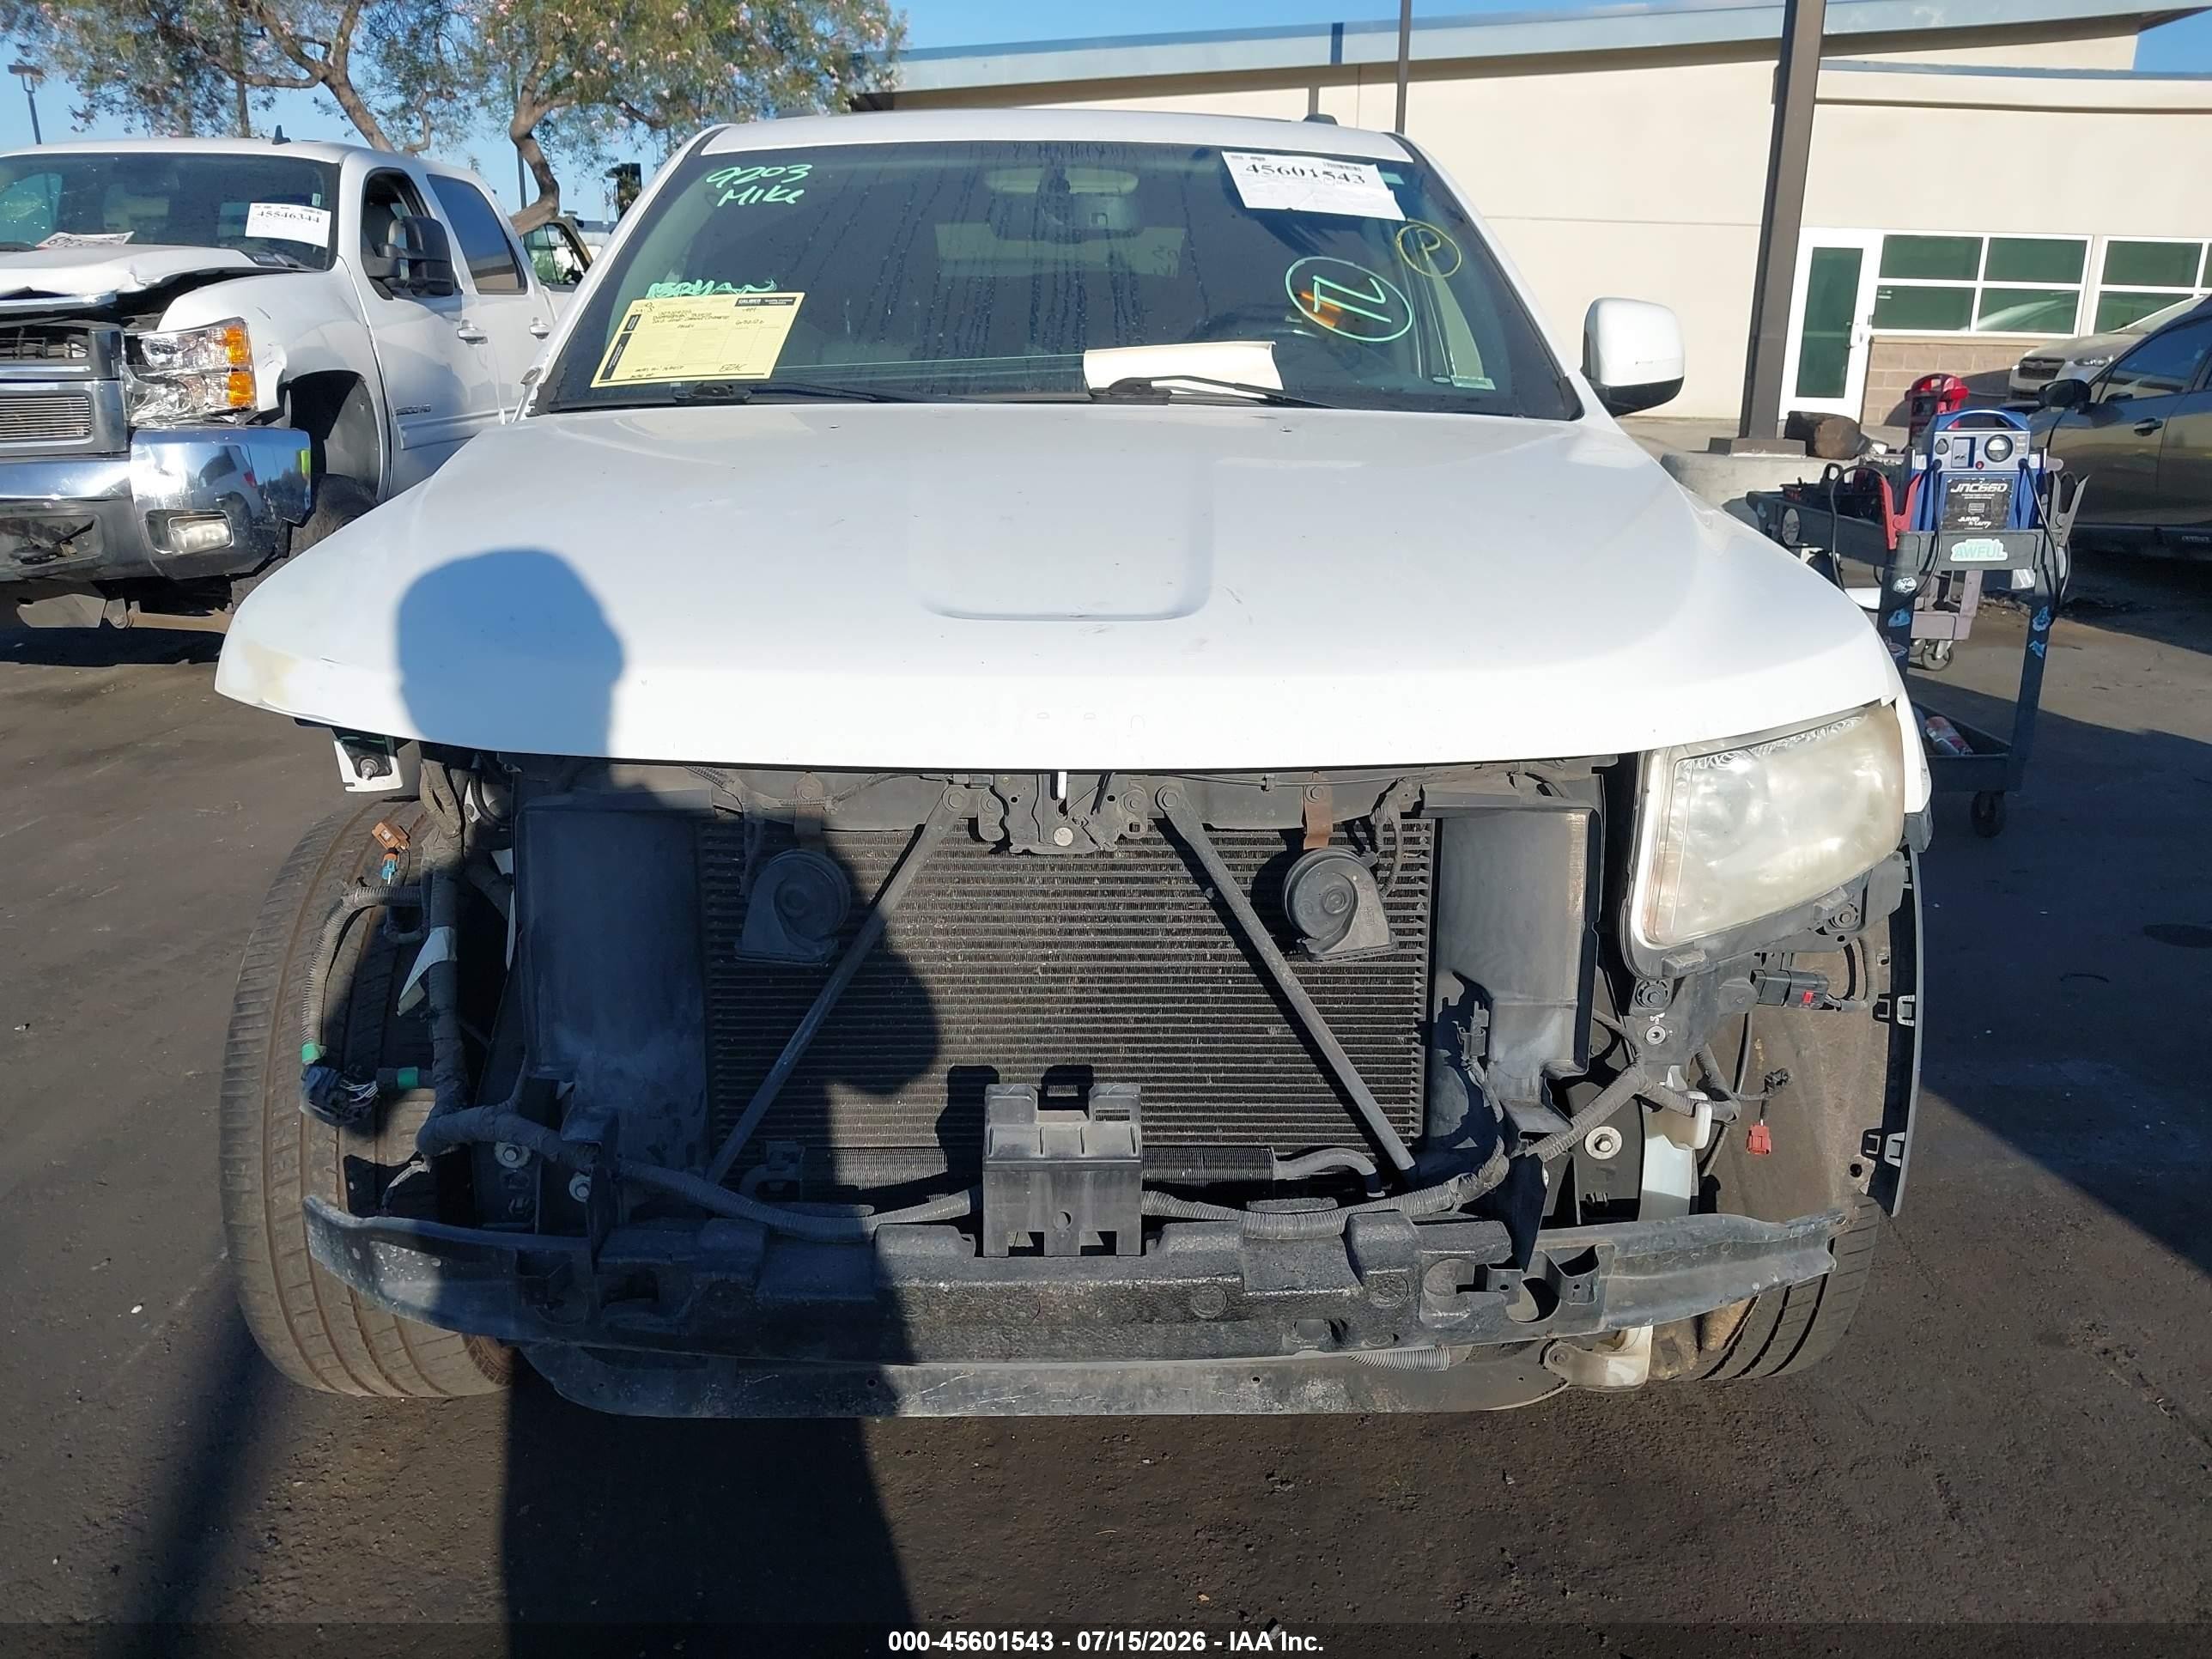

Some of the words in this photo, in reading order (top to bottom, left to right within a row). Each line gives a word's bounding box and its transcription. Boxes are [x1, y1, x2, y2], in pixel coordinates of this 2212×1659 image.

[706, 164, 813, 188] 9203
[1245, 164, 1365, 184] 45601543
[257, 210, 320, 223] 45546344
[1950, 483, 2008, 492] JNC660
[1953, 544, 2007, 558] AWFUL
